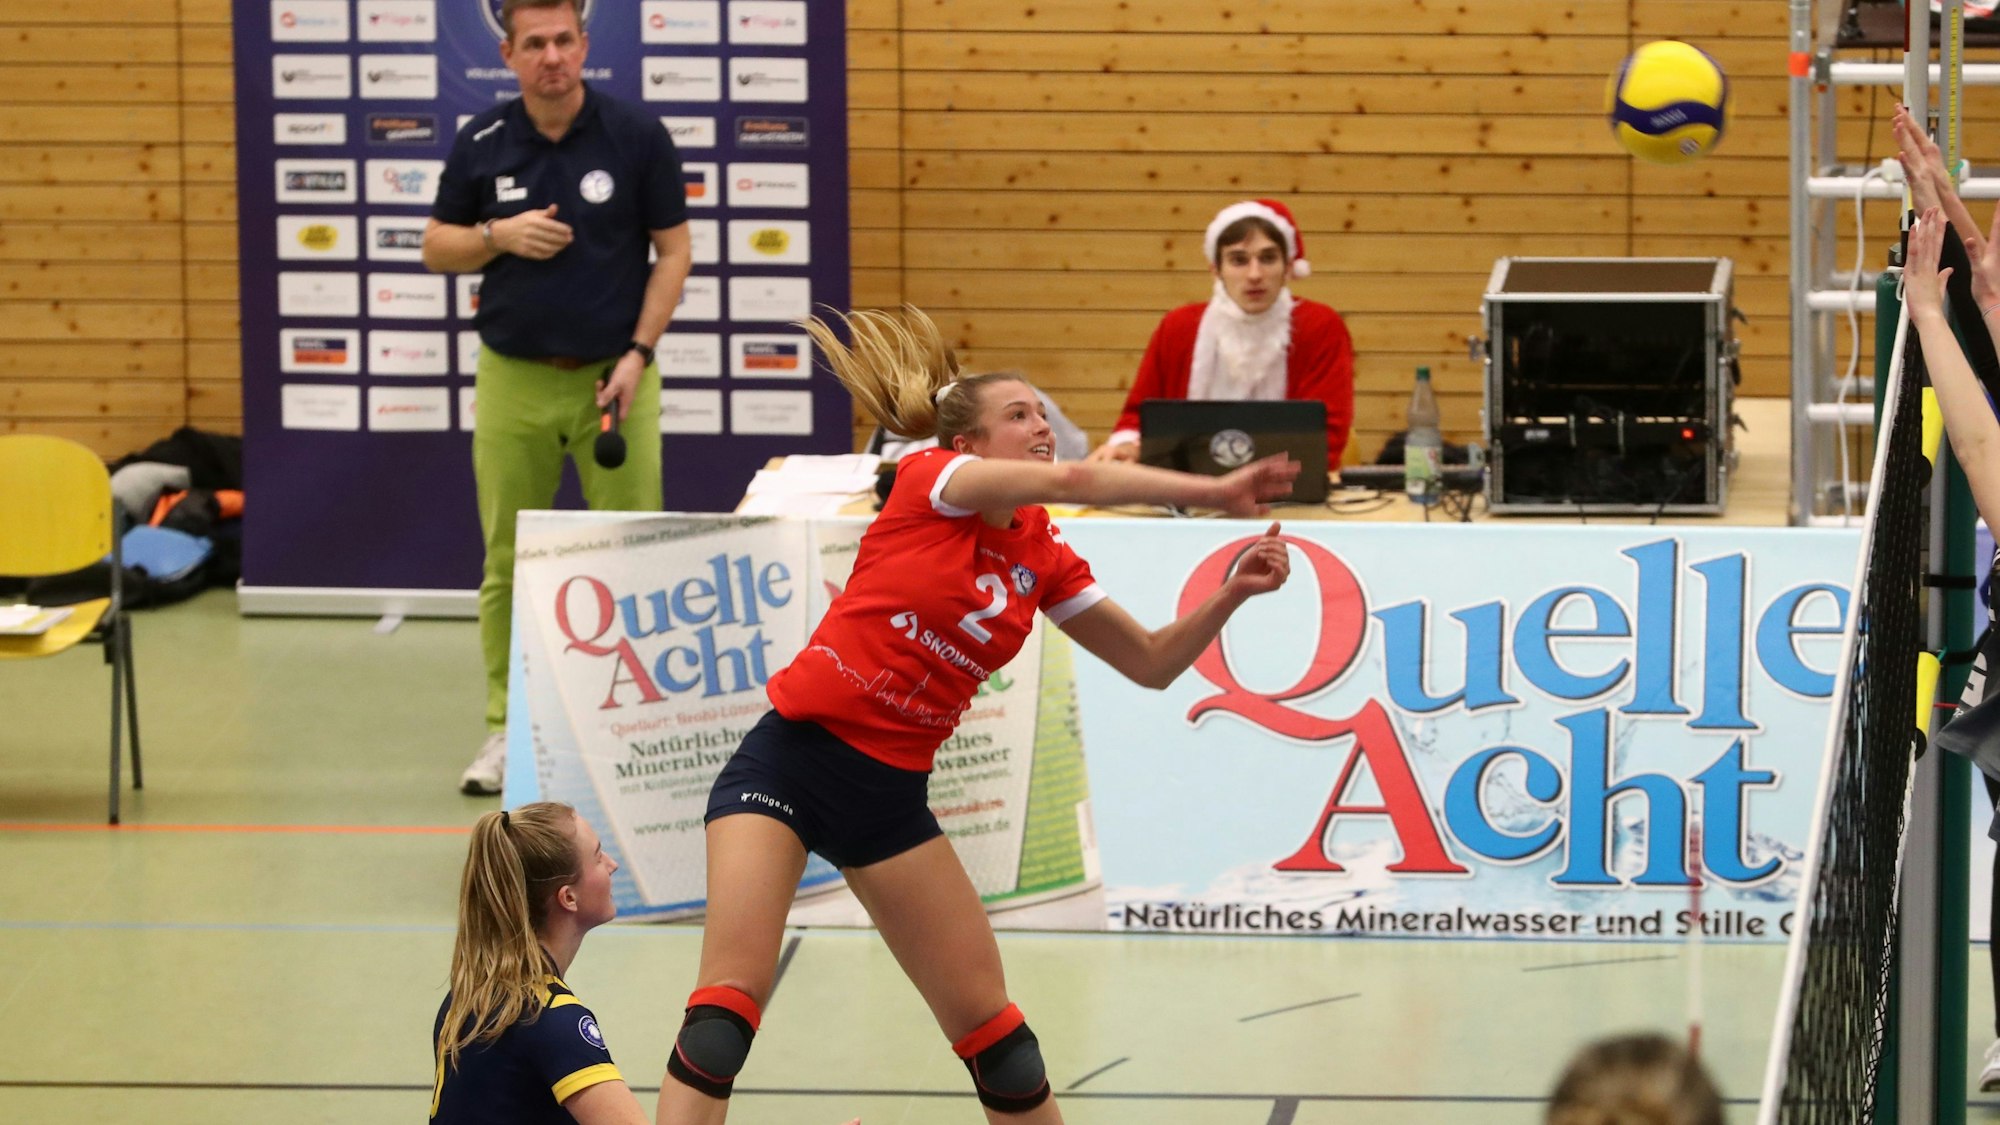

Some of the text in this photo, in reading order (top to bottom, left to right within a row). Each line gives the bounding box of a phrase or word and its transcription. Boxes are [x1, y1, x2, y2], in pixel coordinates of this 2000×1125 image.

[555, 553, 793, 657] Quelle
[958, 573, 1008, 645] 2
[1177, 535, 1851, 741] Quelle
[598, 626, 773, 711] Acht
[615, 748, 734, 781] Mineralwa
[629, 724, 752, 760] Natürliche
[751, 792, 794, 816] Flüge.de
[1272, 697, 1783, 888] Acht
[1123, 903, 1323, 931] Natürliches
[1336, 905, 1582, 936] Mineralwasser
[1596, 911, 1662, 934] und
[1676, 910, 1765, 936] Stille
